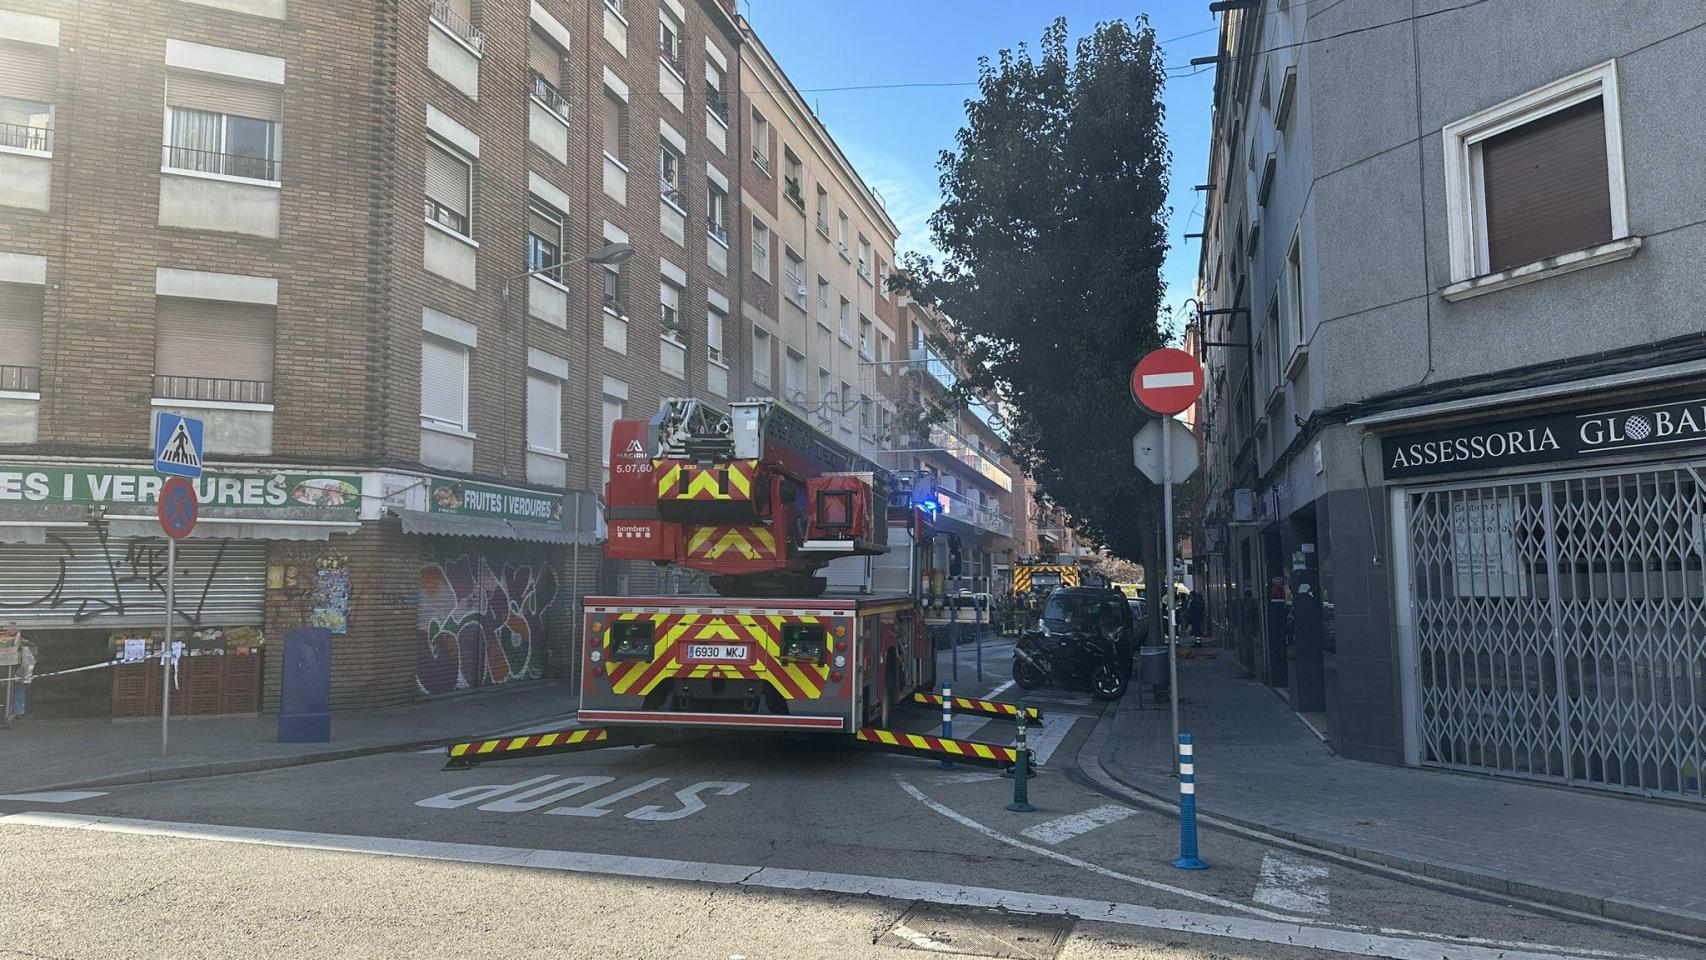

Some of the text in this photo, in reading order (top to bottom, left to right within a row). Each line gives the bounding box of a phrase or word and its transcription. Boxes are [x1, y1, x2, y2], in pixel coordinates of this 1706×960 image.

[1391, 426, 1560, 468] ASSESSORIA
[616, 463, 653, 473] 5.07.60
[0, 471, 288, 505] ES I VERURES
[464, 489, 551, 518] FRUITES I VERDURES
[695, 646, 745, 657] 6930 MKJ
[414, 773, 751, 821] STOP
